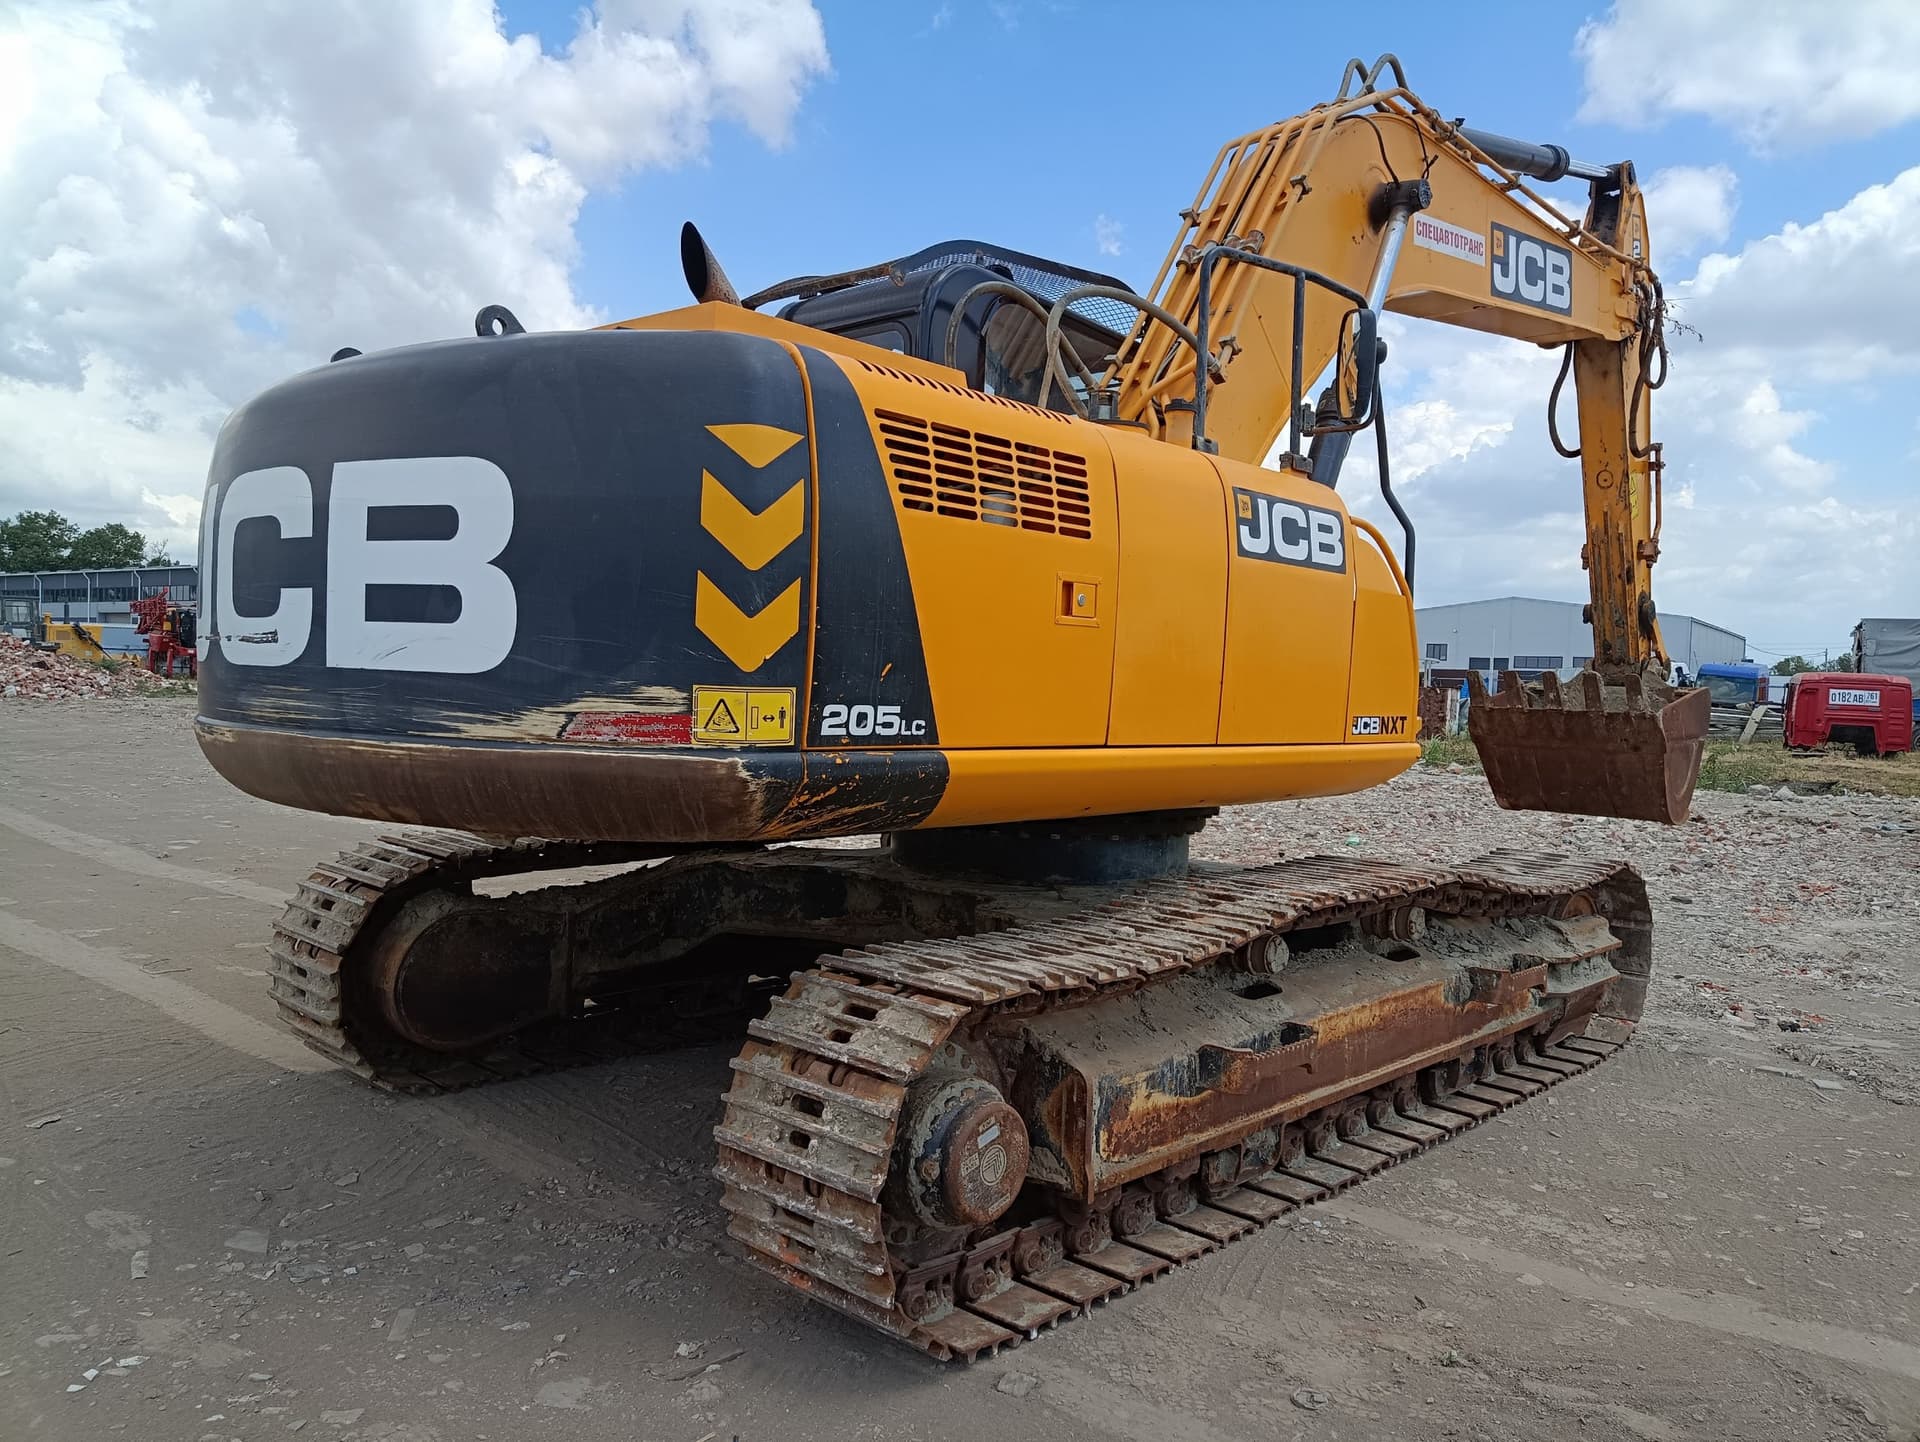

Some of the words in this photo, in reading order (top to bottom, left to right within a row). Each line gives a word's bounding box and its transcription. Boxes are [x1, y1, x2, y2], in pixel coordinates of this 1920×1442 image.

[1416, 220, 1484, 257] СПЕЦАВТОТРАНС
[1493, 234, 1570, 309] JCB
[1239, 498, 1344, 567] JCB
